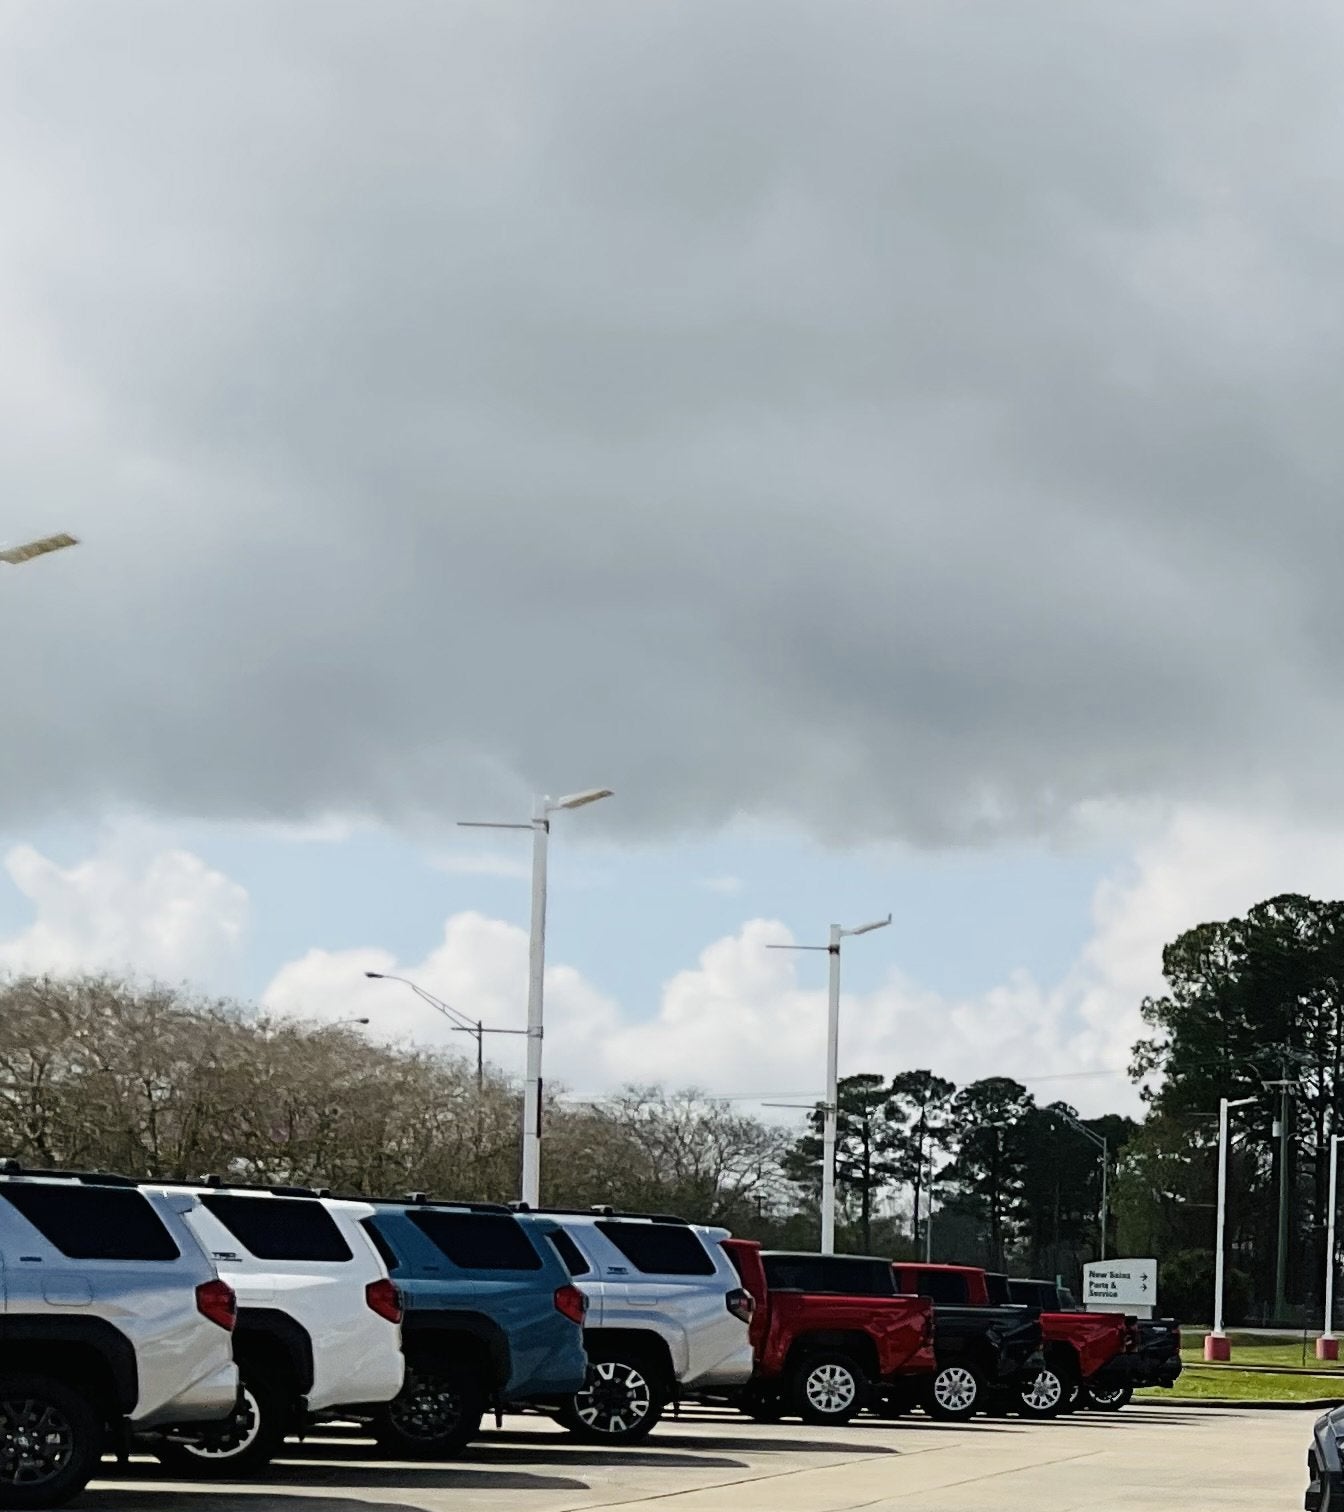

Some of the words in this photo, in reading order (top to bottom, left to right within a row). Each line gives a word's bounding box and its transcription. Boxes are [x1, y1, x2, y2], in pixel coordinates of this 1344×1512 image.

[1088, 1270, 1107, 1278] New
[1088, 1281, 1109, 1289] Parts
[1088, 1290, 1118, 1298] Service
